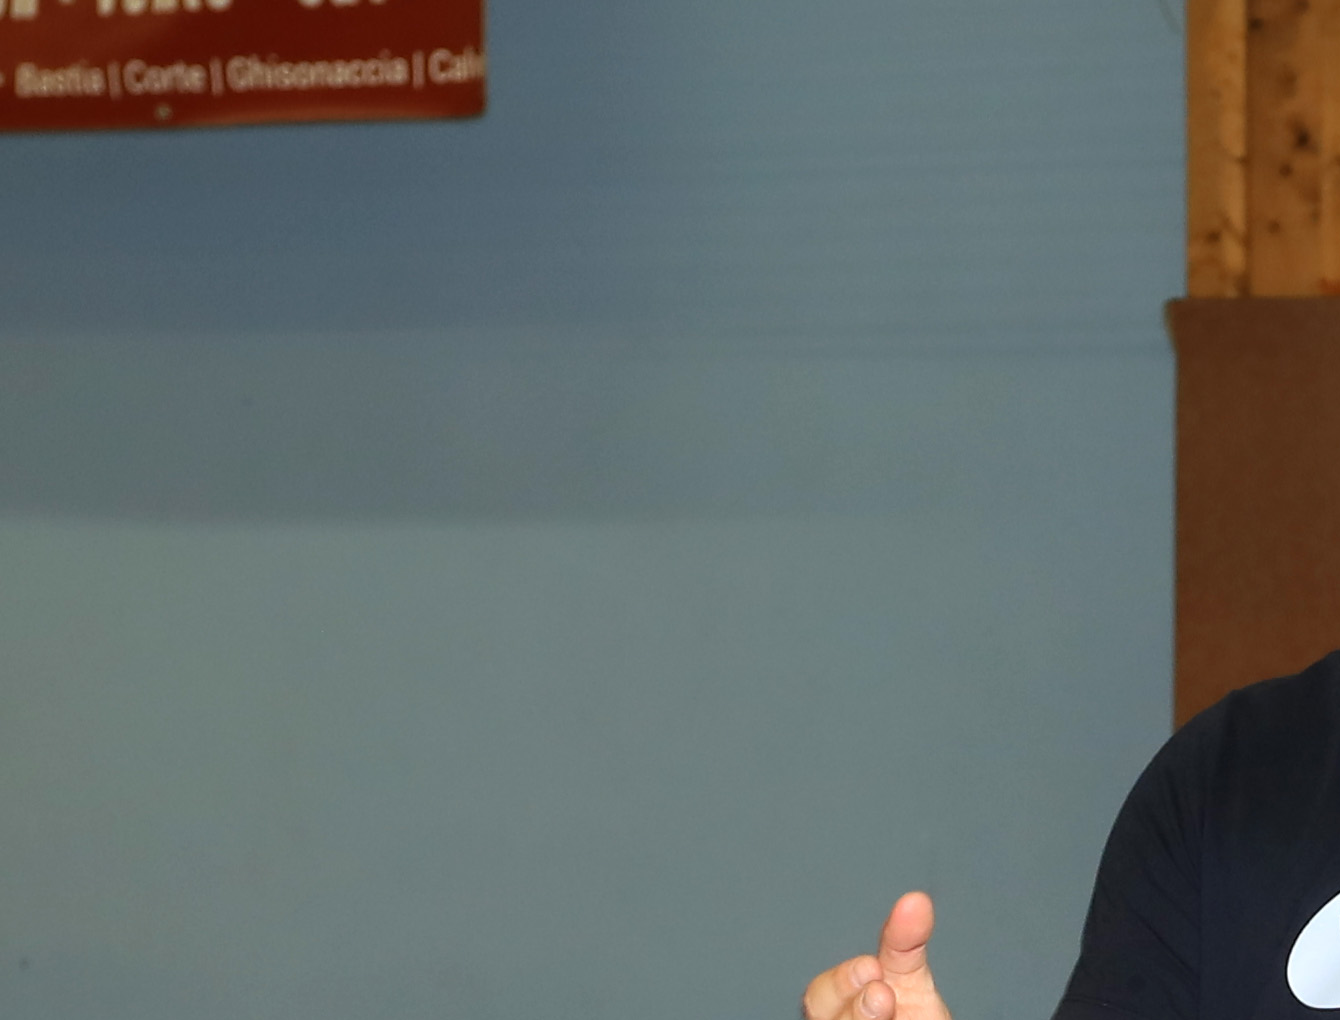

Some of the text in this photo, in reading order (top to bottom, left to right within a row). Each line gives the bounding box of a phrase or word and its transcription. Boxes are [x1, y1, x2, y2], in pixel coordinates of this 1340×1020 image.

[15, 60, 106, 97] Bastia
[123, 59, 207, 95] Corte
[226, 49, 409, 92] Ghisonaccia
